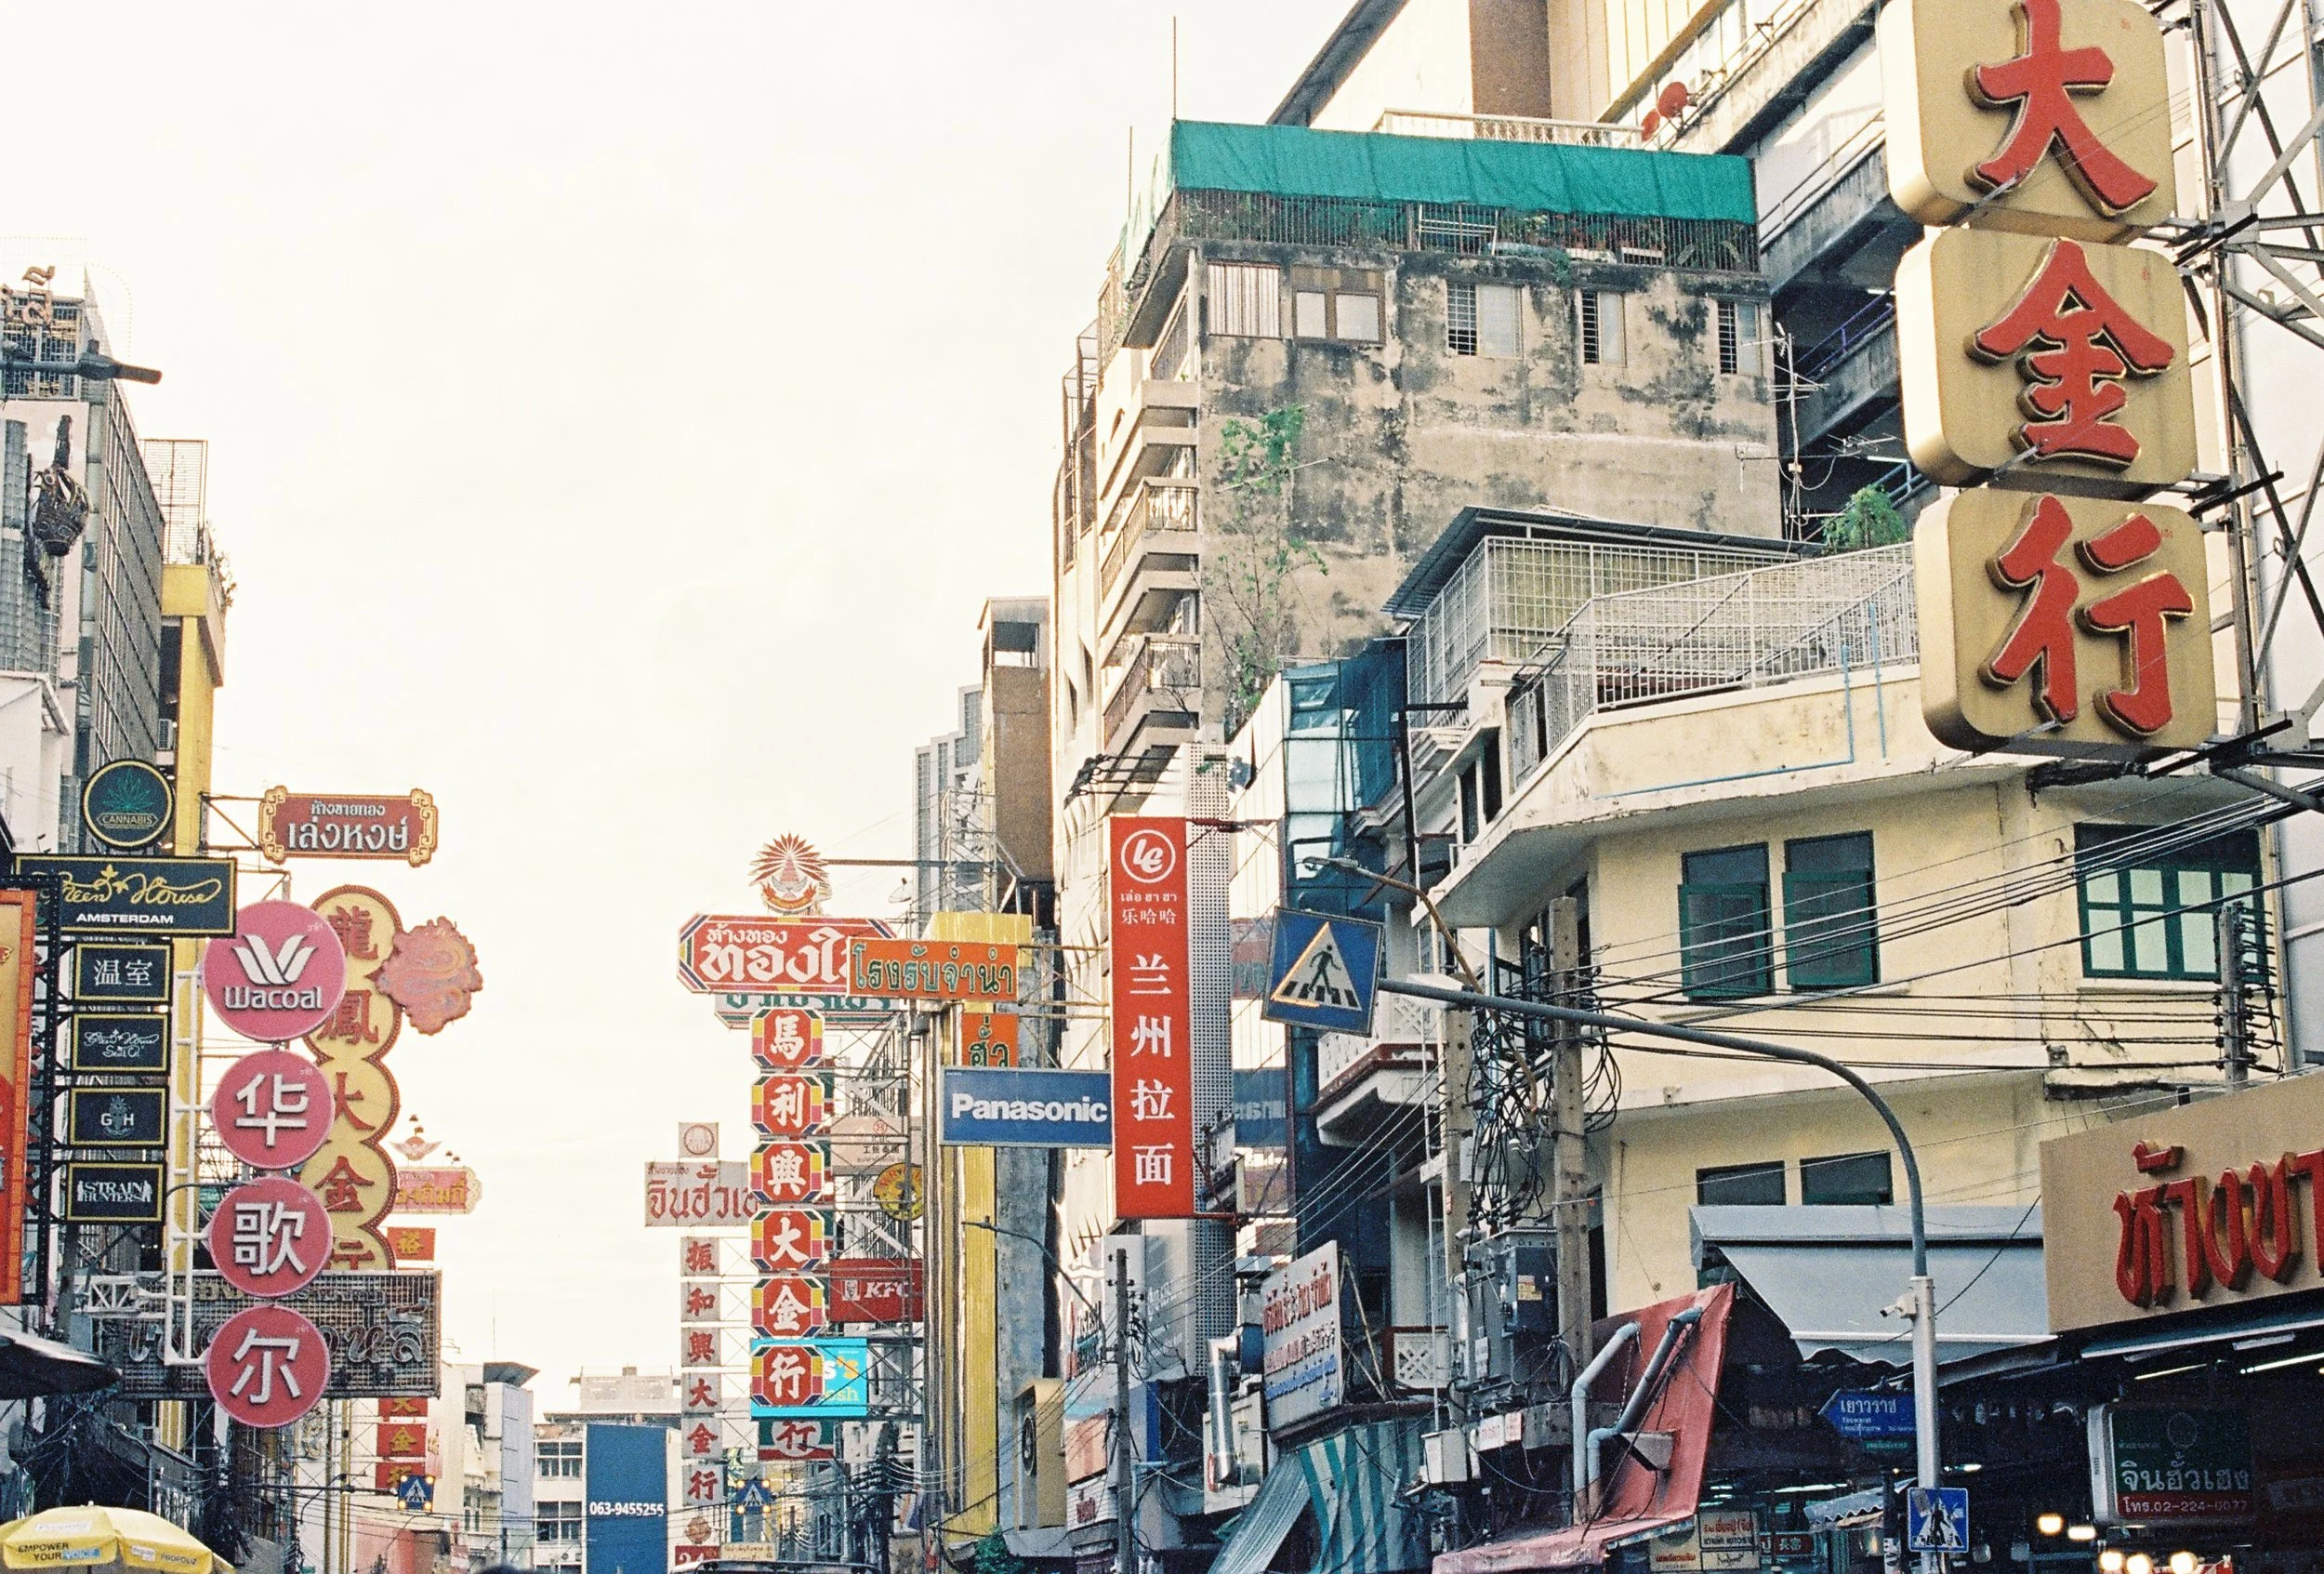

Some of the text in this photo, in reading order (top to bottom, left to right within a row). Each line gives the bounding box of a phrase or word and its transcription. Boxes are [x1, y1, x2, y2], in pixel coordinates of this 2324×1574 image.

[1974, 0, 2195, 734] 大金行
[102, 813, 153, 825] CANNABIS
[310, 800, 386, 816] ห้างขายทอง
[287, 815, 409, 851] เล่งหงษ์
[40, 871, 222, 904] reen House
[75, 913, 175, 924] AMSTERDAM
[1122, 907, 1177, 925] 乐哈哈
[706, 923, 788, 944] ห้างทอง
[699, 927, 849, 983] ทองใ
[93, 959, 153, 986] 温室
[852, 942, 1014, 995] โรงรับจำนำ
[223, 985, 324, 1010] Wacoal
[1129, 953, 1175, 1186] 兰州拉面
[951, 1091, 1109, 1123] Panasonic
[85, 1181, 143, 1194] STRAIN
[767, 1014, 810, 1398] 馬利興大金行
[230, 1071, 309, 1405] 华歌尔
[864, 1281, 914, 1299] KFC
[685, 1240, 719, 1501] 振和興大金行
[1841, 1399, 1897, 1413] เยาวราช
[588, 1501, 665, 1516] 063-9455255
[18, 1542, 69, 1553] EMPOWER
[33, 1551, 62, 1561] YOUR
